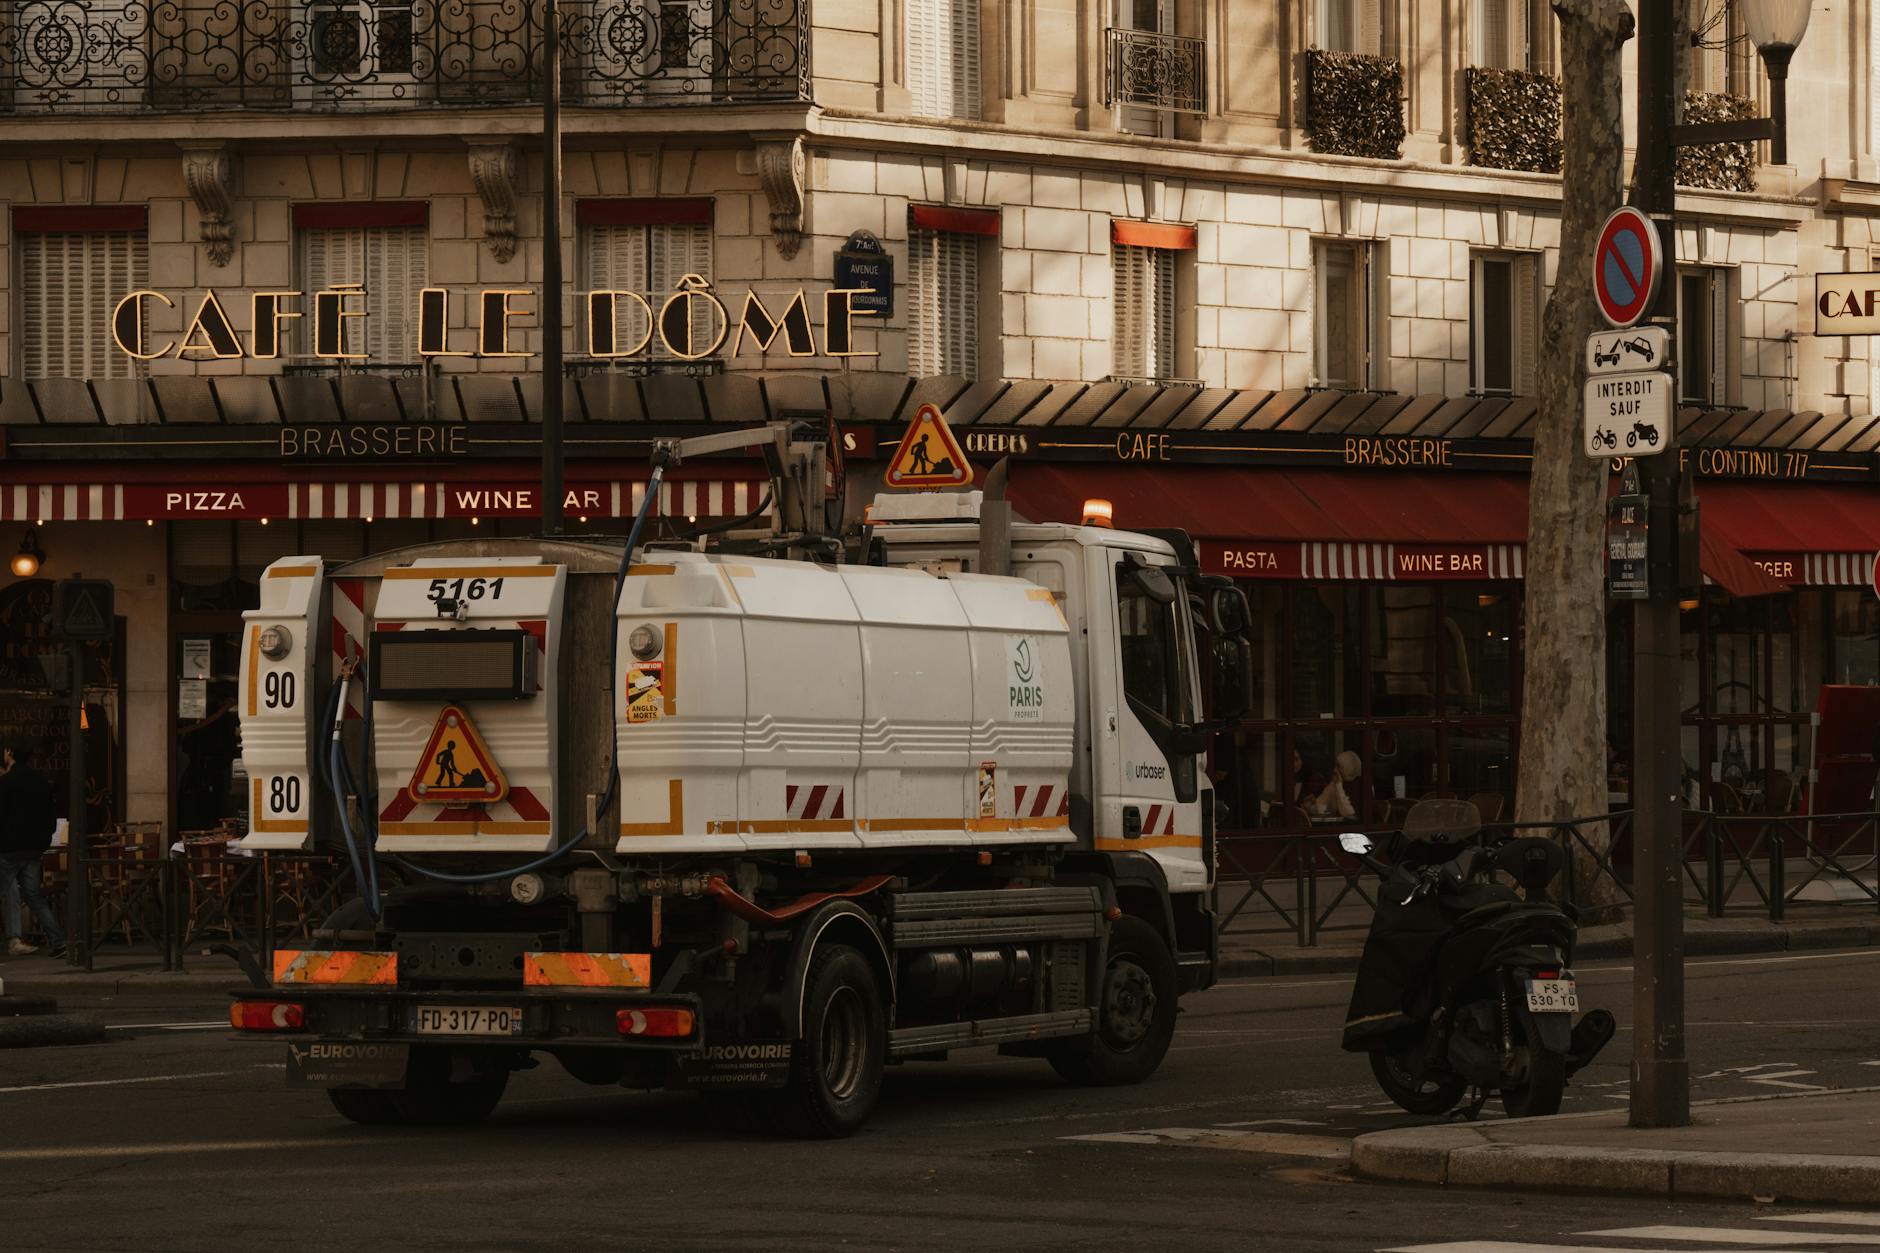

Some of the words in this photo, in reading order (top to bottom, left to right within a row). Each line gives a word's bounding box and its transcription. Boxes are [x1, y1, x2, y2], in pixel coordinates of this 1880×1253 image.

[851, 264, 879, 275] AVENUE
[112, 284, 372, 360] CAFÉ
[418, 288, 538, 357] LE
[588, 274, 881, 358] DÔME
[1597, 380, 1653, 398] INTERDIT
[1610, 400, 1641, 416] SAUF
[280, 426, 468, 456] BRASSERIE
[1116, 432, 1171, 461] CAFE
[1345, 438, 1453, 466] BRASSERIE
[1699, 449, 1779, 477] CONTINU
[1783, 452, 1809, 479] 7/7
[166, 492, 246, 511] PIZZA
[456, 490, 532, 509] WINE
[563, 490, 600, 509] AR
[1223, 551, 1278, 569] PASTA
[1400, 554, 1444, 571] WINE
[1450, 554, 1482, 571] BAR
[427, 578, 504, 600] 5161
[265, 672, 295, 708] 90
[1010, 686, 1043, 707] PARIS
[1136, 762, 1165, 779] urbaser
[271, 776, 300, 813] 80
